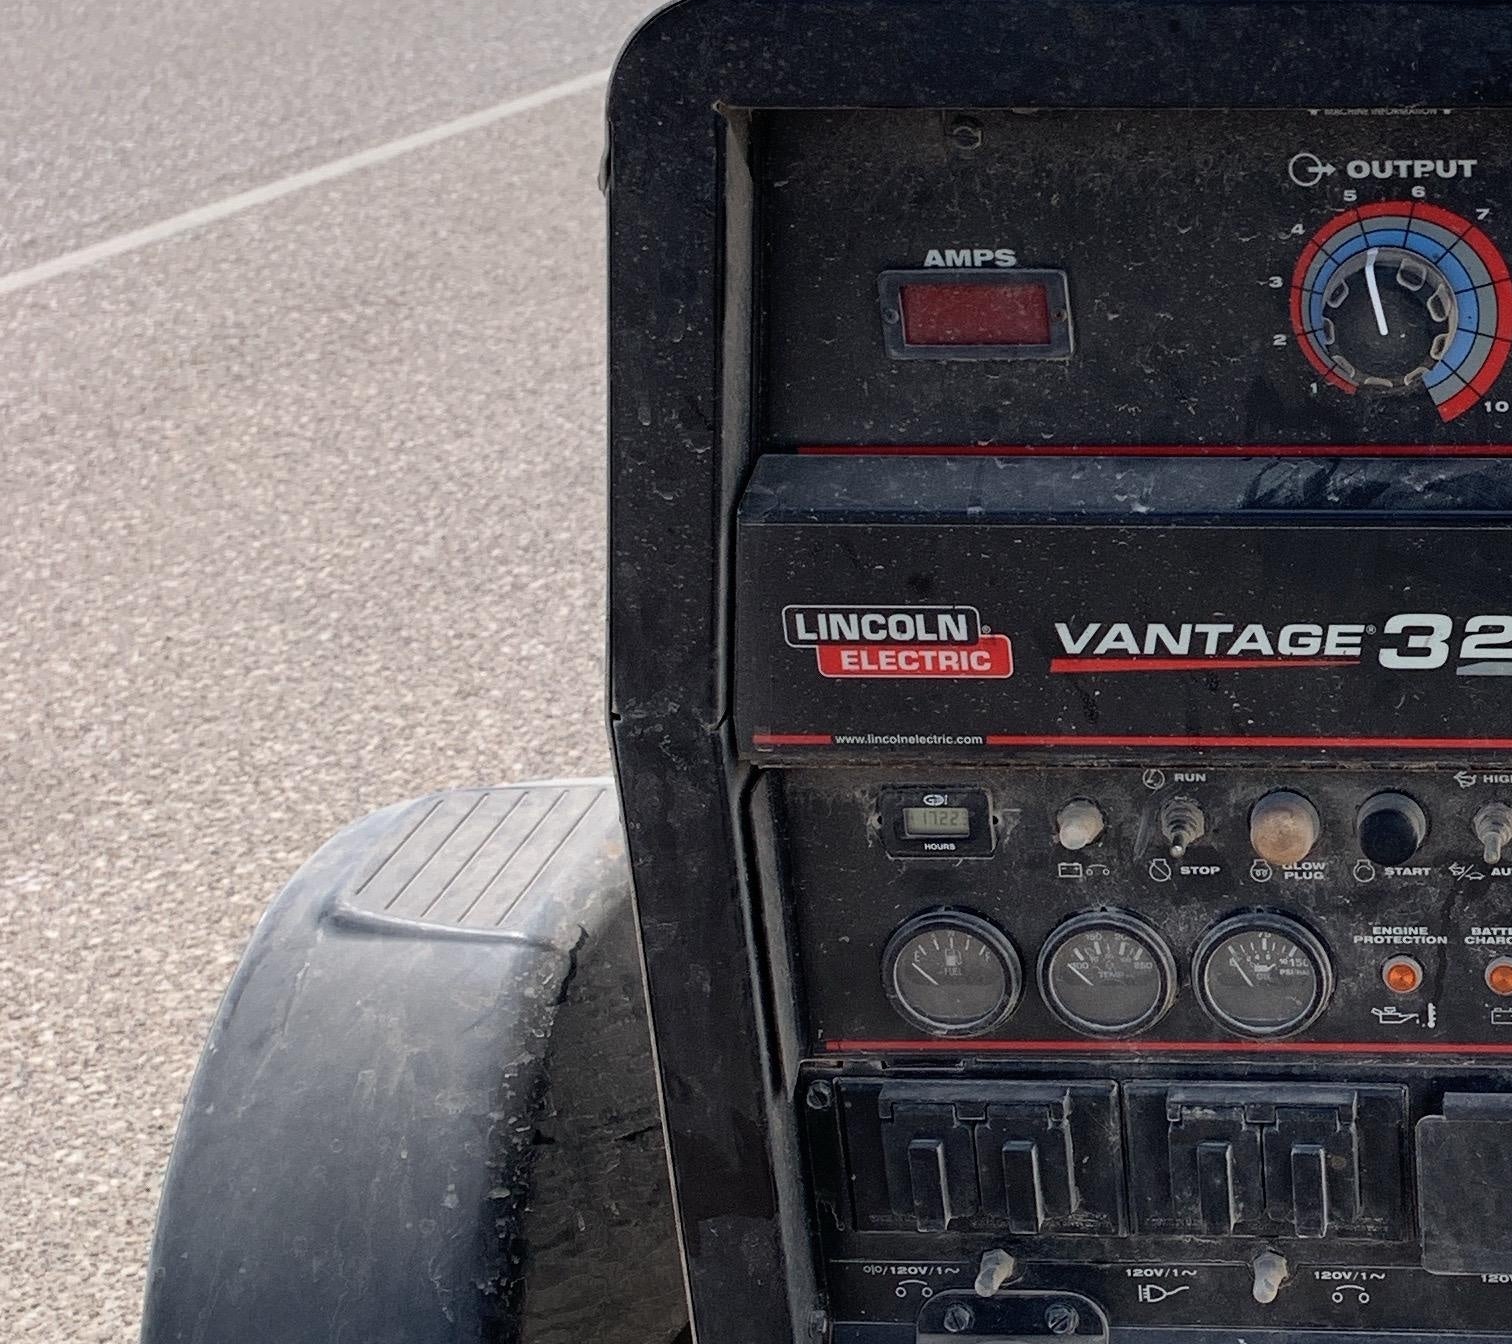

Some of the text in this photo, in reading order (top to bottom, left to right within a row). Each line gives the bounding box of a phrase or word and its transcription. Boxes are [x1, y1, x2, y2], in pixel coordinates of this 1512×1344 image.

[1347, 159, 1478, 179] OUTPUT
[1343, 189, 1356, 201] 5
[1412, 187, 1426, 198] 6
[1477, 209, 1490, 221] 7
[1291, 224, 1305, 236] 4
[923, 248, 1018, 268] AMPS
[1269, 276, 1283, 288] 3
[1273, 334, 1287, 346] 2
[1309, 383, 1319, 395] 1
[1484, 400, 1510, 413] 10
[794, 613, 968, 642] LINCOLN
[841, 650, 992, 672] ELECTRIC
[835, 734, 983, 746] www.lincolnelectric.com
[1174, 773, 1206, 783] RUN
[924, 843, 956, 851] HOURS
[1180, 866, 1221, 876] STOP
[1284, 871, 1325, 881] PLUG
[1385, 867, 1431, 877] START
[1372, 927, 1429, 936] ENGINE
[1353, 936, 1448, 946] PROTECTION
